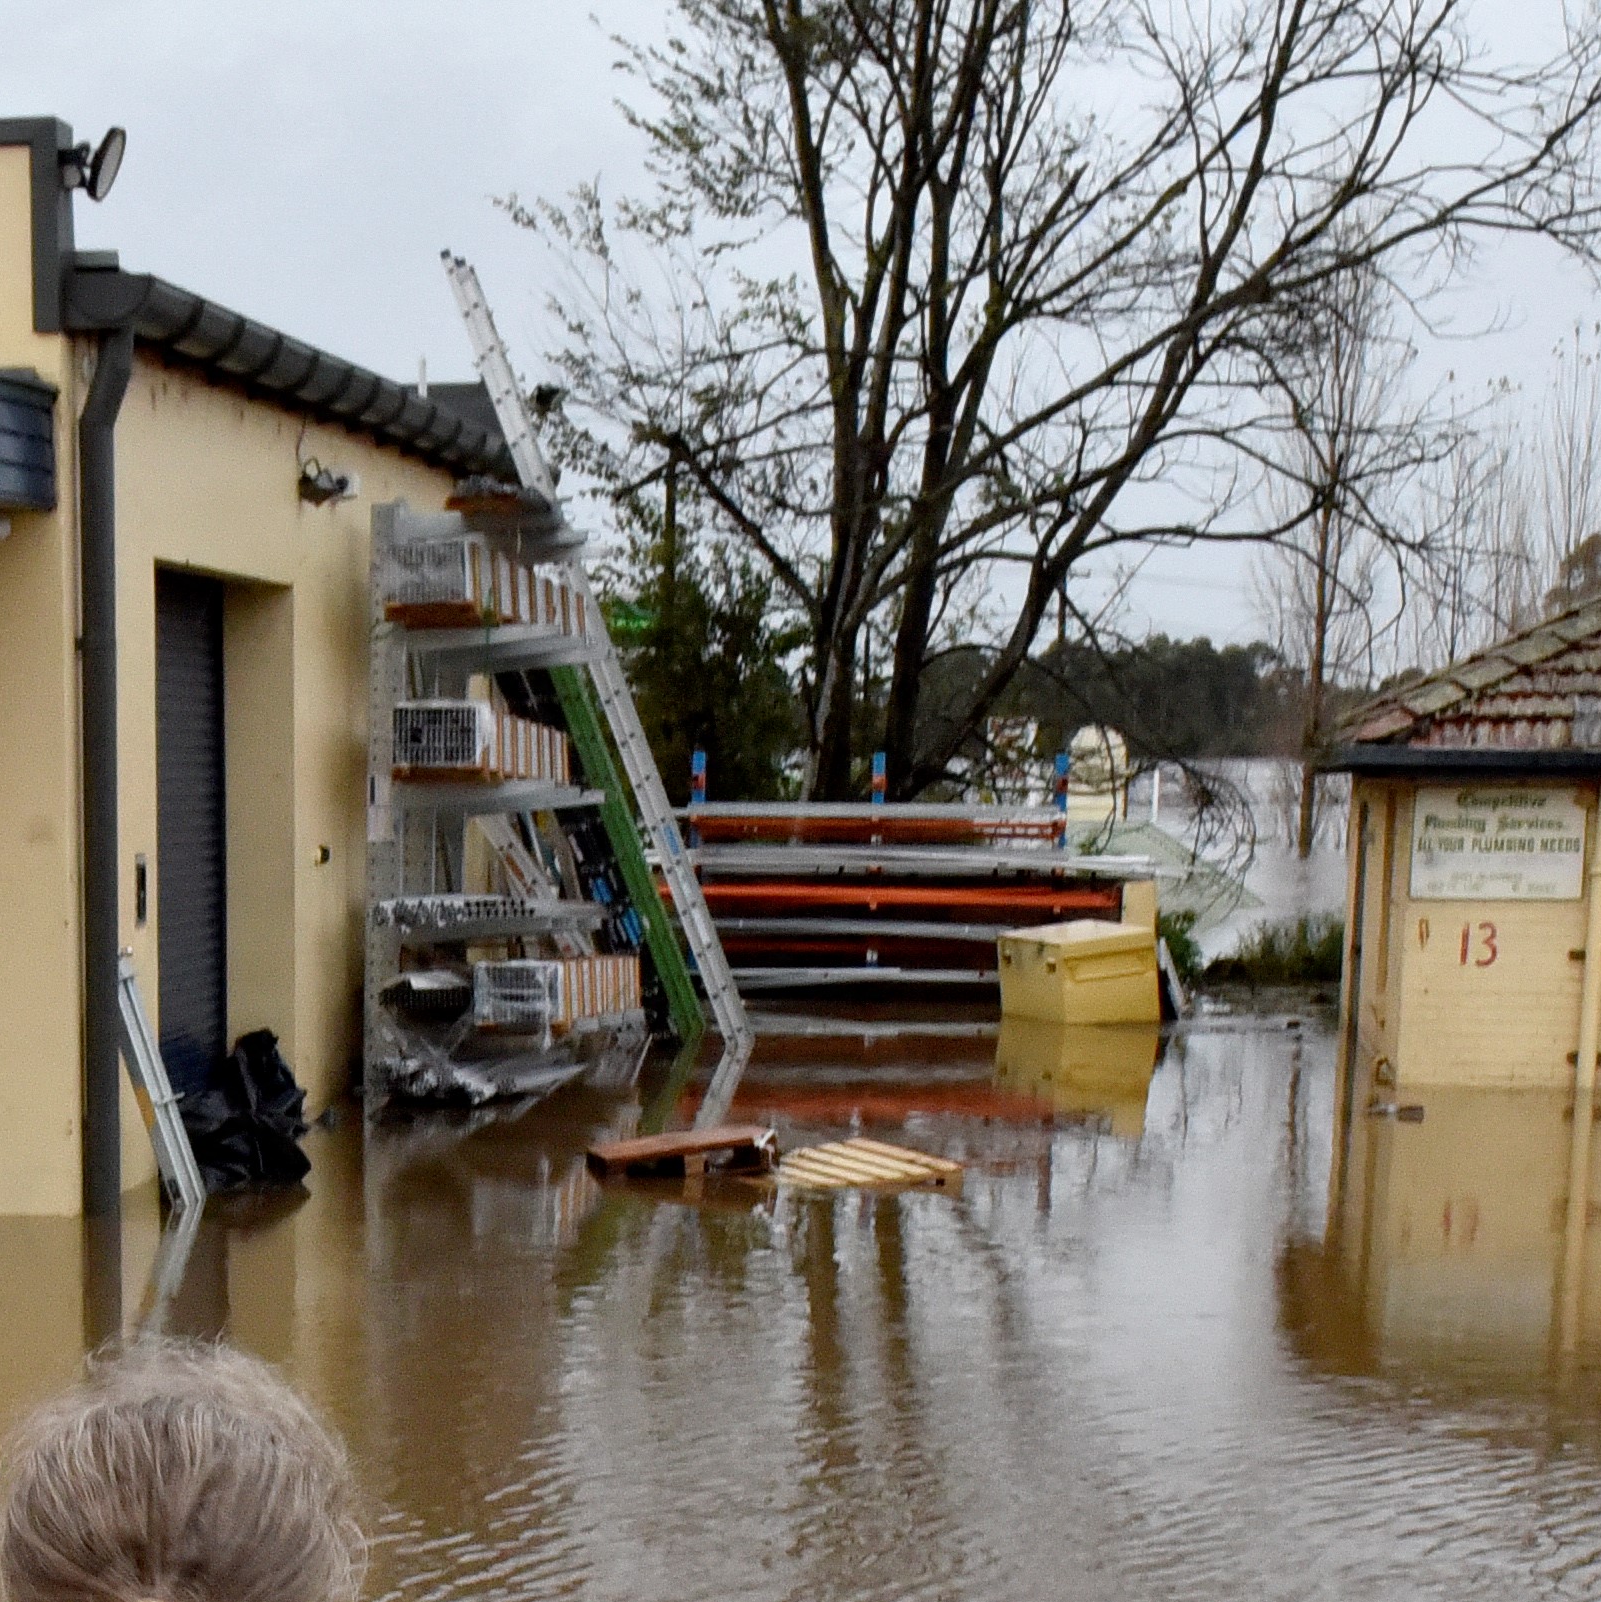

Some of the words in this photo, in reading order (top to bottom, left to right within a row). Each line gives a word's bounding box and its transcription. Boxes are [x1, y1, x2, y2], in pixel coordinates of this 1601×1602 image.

[1471, 837, 1535, 853] PLUMBING
[1540, 837, 1580, 853] NEEDS
[1460, 921, 1498, 967] 13
